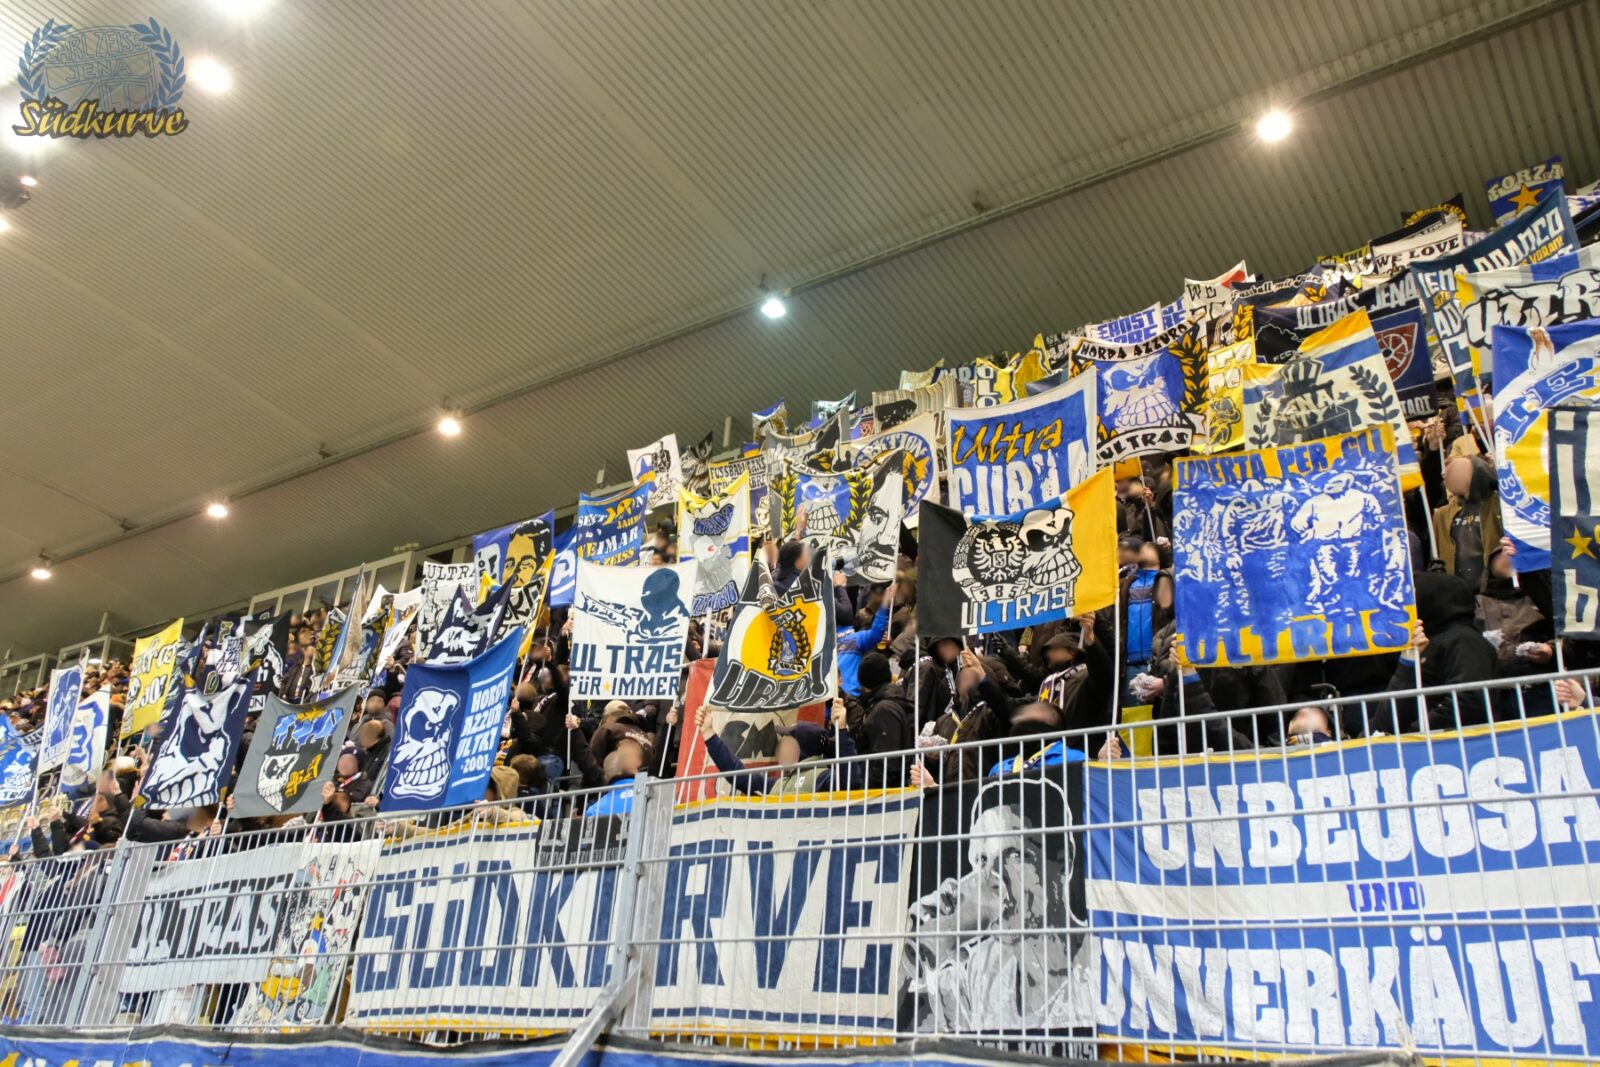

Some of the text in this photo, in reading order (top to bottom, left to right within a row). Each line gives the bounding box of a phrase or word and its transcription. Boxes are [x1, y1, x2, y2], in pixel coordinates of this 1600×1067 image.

[1409, 238, 1459, 259] LOVE
[1294, 294, 1361, 330] ULTRAS
[1369, 270, 1417, 311] JENA
[1097, 308, 1156, 340] ERNST
[951, 418, 1064, 466] Ultra
[1099, 429, 1189, 460] ULTRAS
[1276, 442, 1329, 479] PER
[961, 579, 1077, 629] ULTRAS!
[1178, 608, 1412, 665] ULTRAS
[570, 643, 683, 674] ULTRAS
[569, 676, 680, 696] FÜR IMMER
[1346, 881, 1426, 913] UND
[128, 880, 286, 962] ULTRAS
